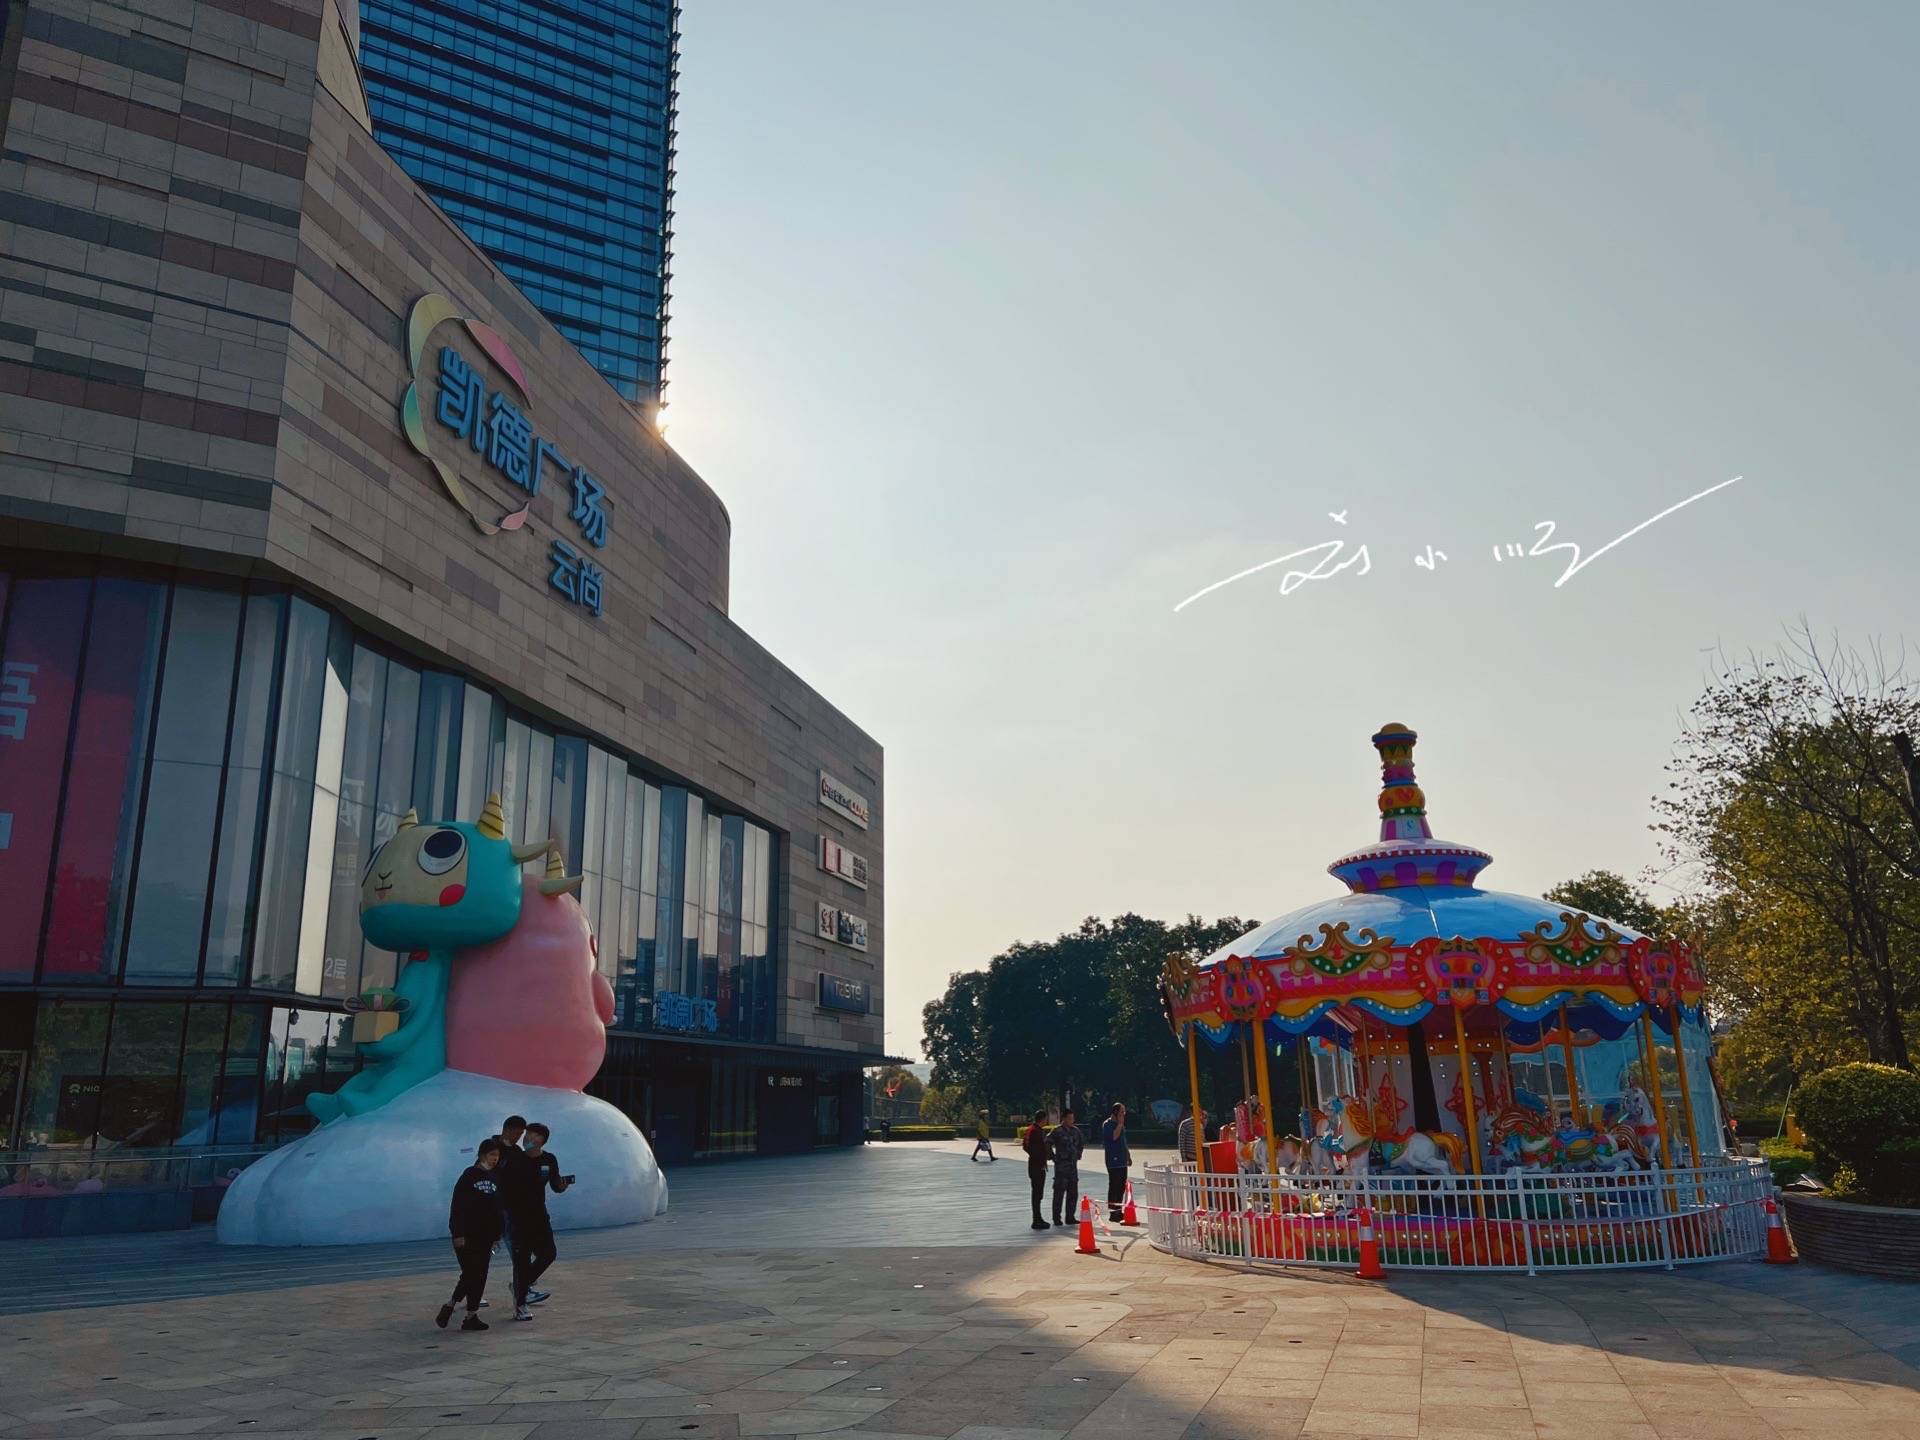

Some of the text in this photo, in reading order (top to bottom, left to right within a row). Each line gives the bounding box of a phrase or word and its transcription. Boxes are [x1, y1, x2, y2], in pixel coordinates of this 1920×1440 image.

[437, 346, 608, 548] 凯德广场
[548, 539, 603, 618] 云尚
[659, 991, 719, 1033] 凯德广场
